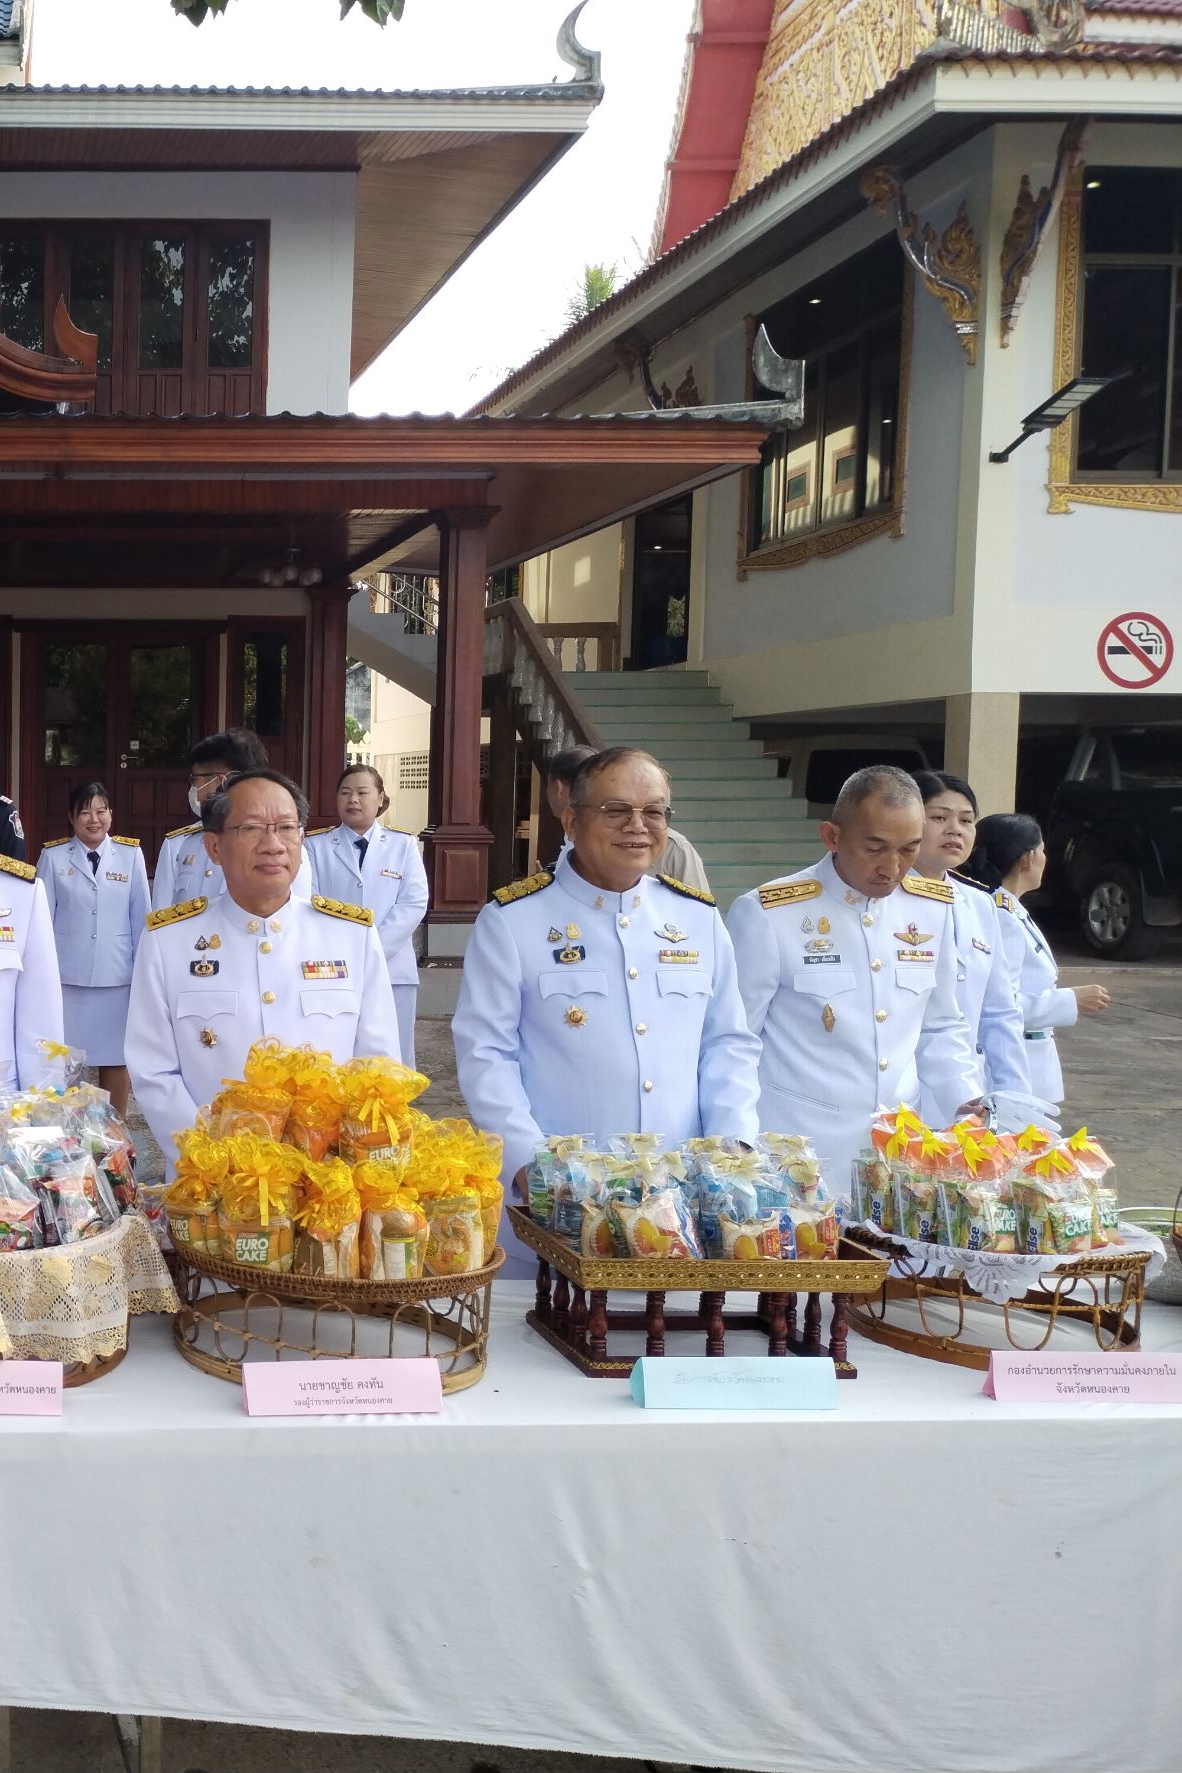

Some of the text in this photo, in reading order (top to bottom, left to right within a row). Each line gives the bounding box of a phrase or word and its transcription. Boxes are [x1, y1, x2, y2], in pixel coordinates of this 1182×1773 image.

[236, 1238, 269, 1251] EURO
[236, 1250, 267, 1261] CAKE
[1007, 1361, 1177, 1376] กองอำนวยการรักษาความมั่นคงภายใน
[298, 1378, 353, 1393] นายชาญชัย
[1056, 1382, 1130, 1395] จังหวัดหนองคาย
